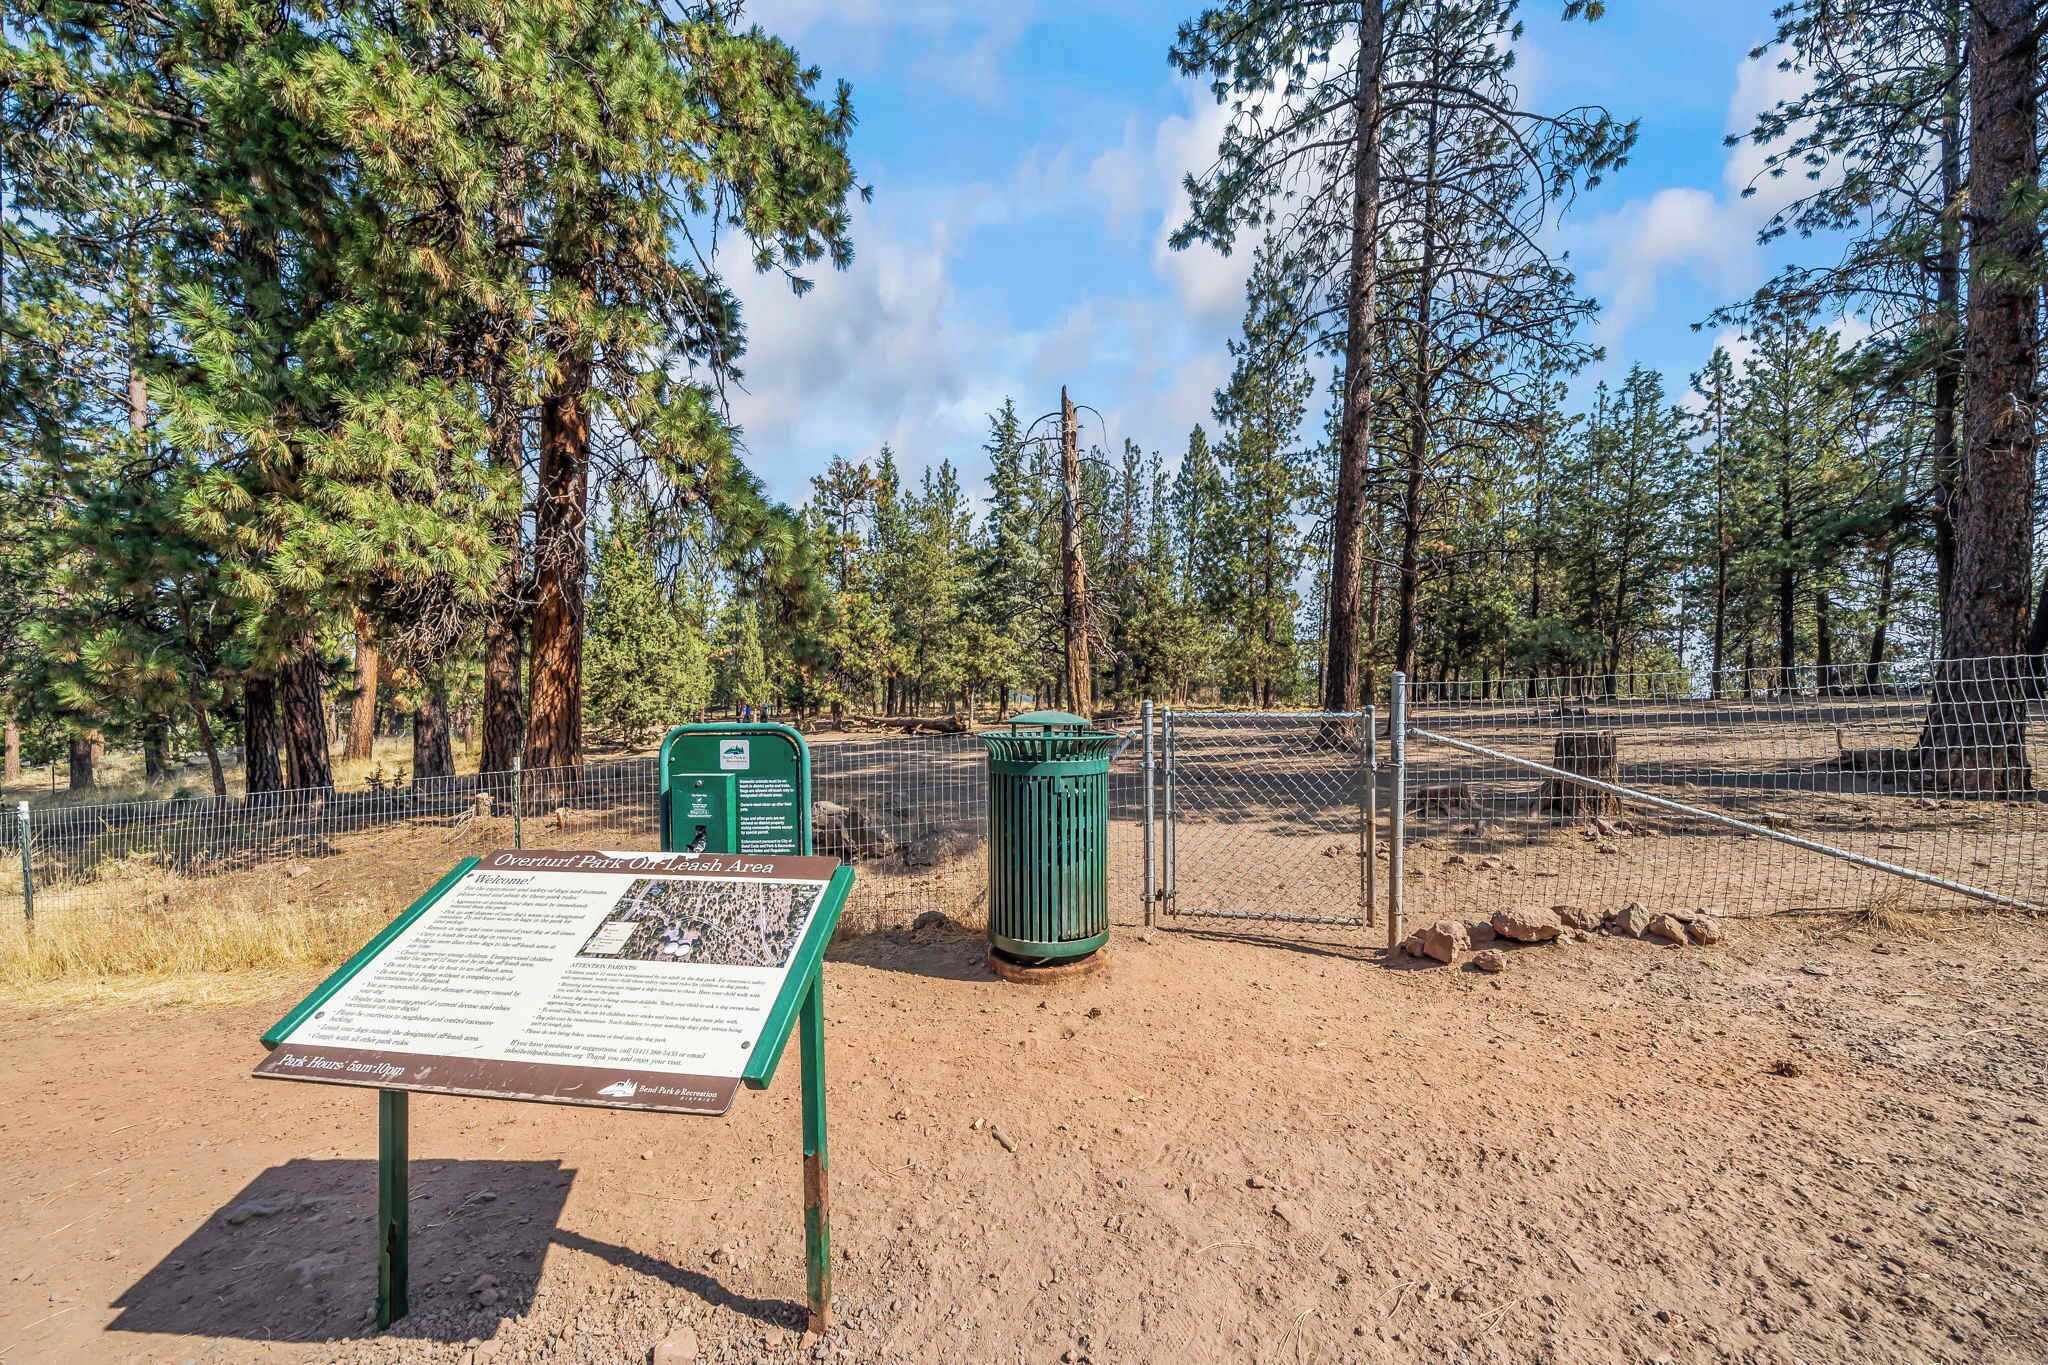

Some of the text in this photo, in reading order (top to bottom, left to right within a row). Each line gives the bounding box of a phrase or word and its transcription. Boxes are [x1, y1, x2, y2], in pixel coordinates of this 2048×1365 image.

[494, 853, 577, 868] Overturf
[575, 855, 624, 869] Park
[727, 860, 774, 874] Area
[474, 874, 536, 885] Welcome!
[278, 1054, 307, 1068] Park
[345, 1060, 405, 1079] 5am-10pm
[639, 1085, 657, 1094] Bend
[658, 1086, 674, 1096] Park
[681, 1089, 718, 1098] Recreation
